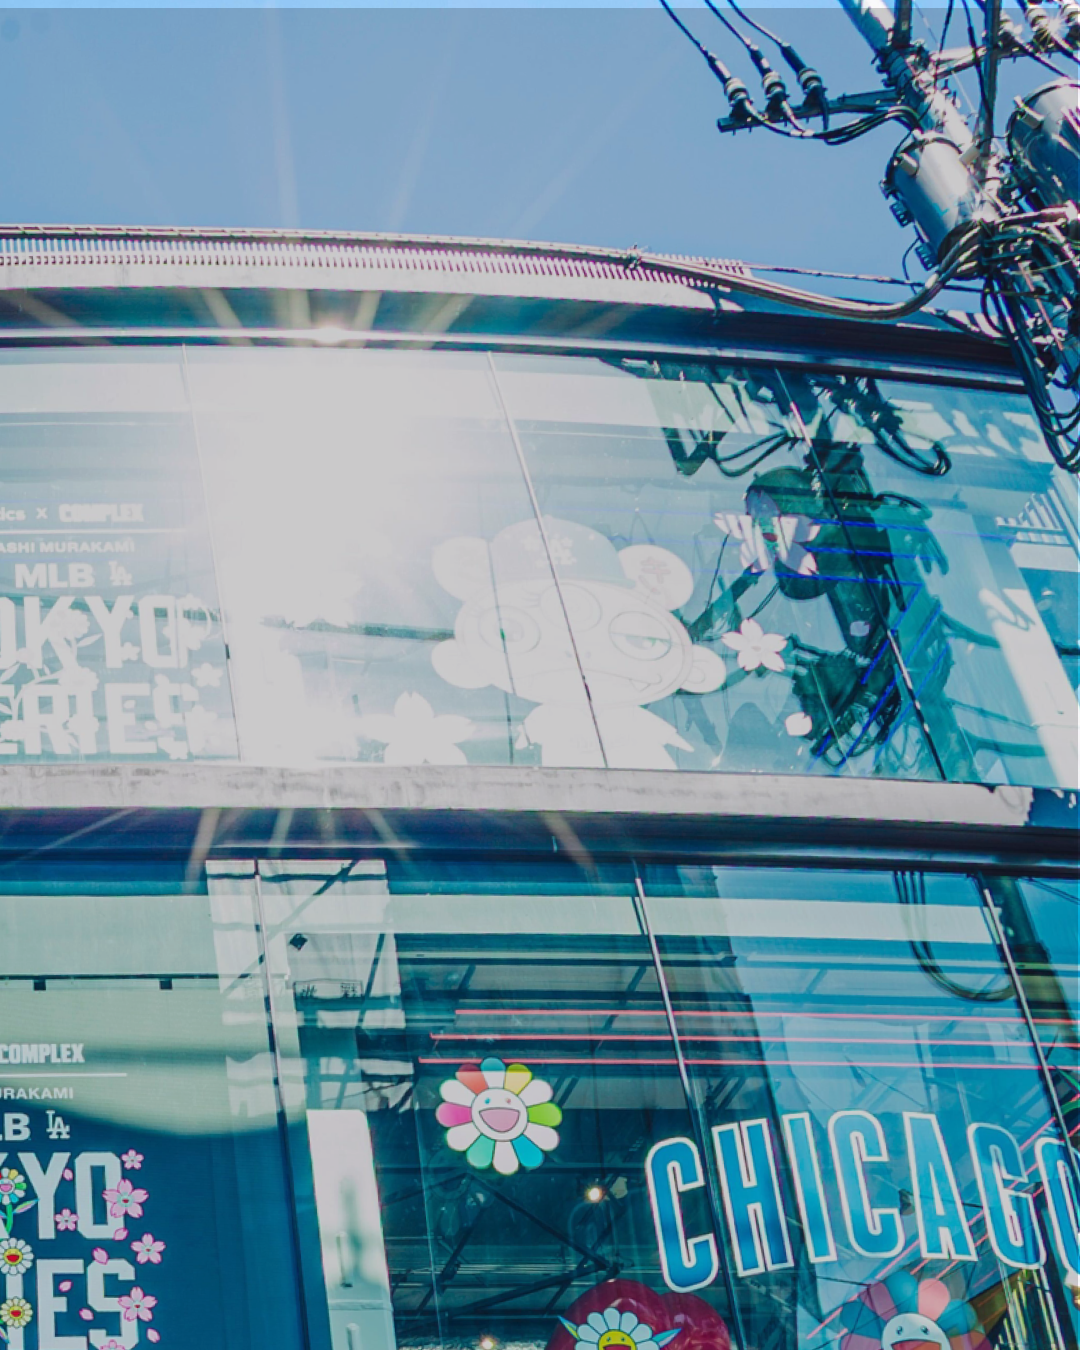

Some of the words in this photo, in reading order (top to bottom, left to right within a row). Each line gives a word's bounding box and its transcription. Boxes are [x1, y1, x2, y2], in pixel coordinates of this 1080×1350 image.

[58, 503, 144, 522] COMPLEX
[39, 539, 135, 553] MURAKAMI
[15, 563, 95, 588] MLB
